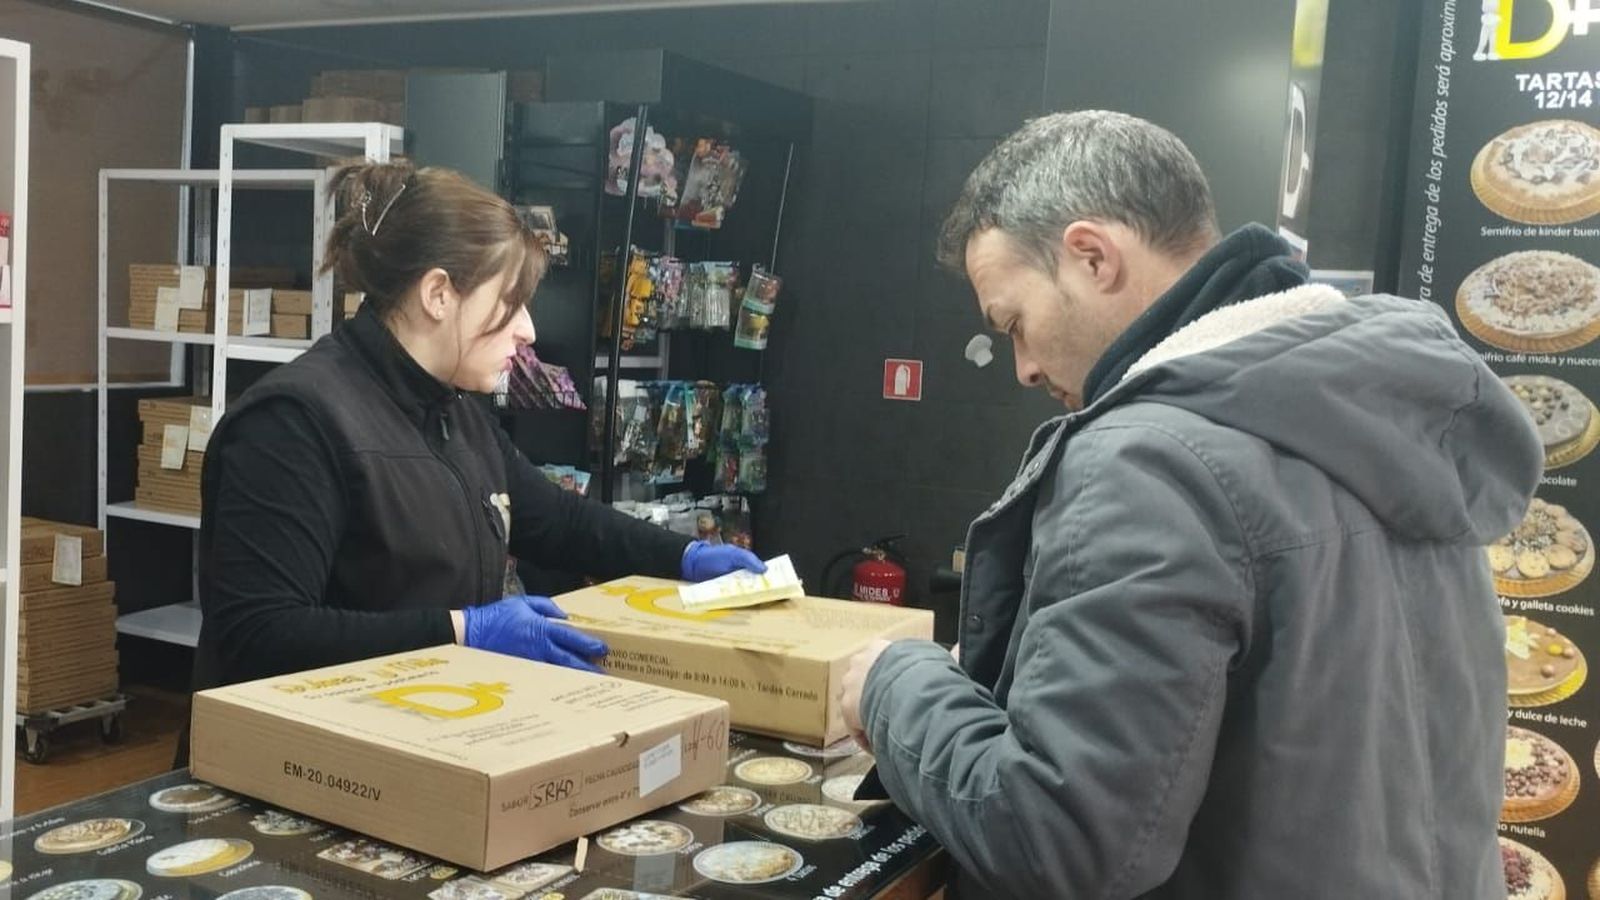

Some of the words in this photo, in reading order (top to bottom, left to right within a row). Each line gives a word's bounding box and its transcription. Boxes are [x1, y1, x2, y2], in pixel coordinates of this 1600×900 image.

[1440, 0, 1457, 62] aproxim
[1435, 65, 1451, 97] será
[1534, 90, 1592, 109] 12/14
[1430, 100, 1448, 159] pedidos
[1425, 160, 1442, 181] los
[1424, 183, 1441, 203] de
[1422, 205, 1442, 262] entrega
[1523, 226, 1537, 237] de
[1539, 226, 1571, 237] kinder
[1417, 264, 1433, 284] de
[1505, 352, 1527, 364] café
[1528, 354, 1557, 365] moka
[1558, 357, 1565, 367] y
[1541, 474, 1577, 487] ocolate
[1511, 599, 1518, 609] y
[1520, 599, 1554, 611] galleta
[1556, 604, 1594, 616] cookies
[614, 660, 638, 671] Martes
[757, 681, 784, 695] Tardes
[1507, 708, 1514, 719] y
[1515, 709, 1543, 721] dulce
[1544, 713, 1558, 724] de
[1560, 715, 1588, 728] leche
[284, 761, 381, 801] EM-20.04922/V
[1510, 824, 1546, 838] nutella
